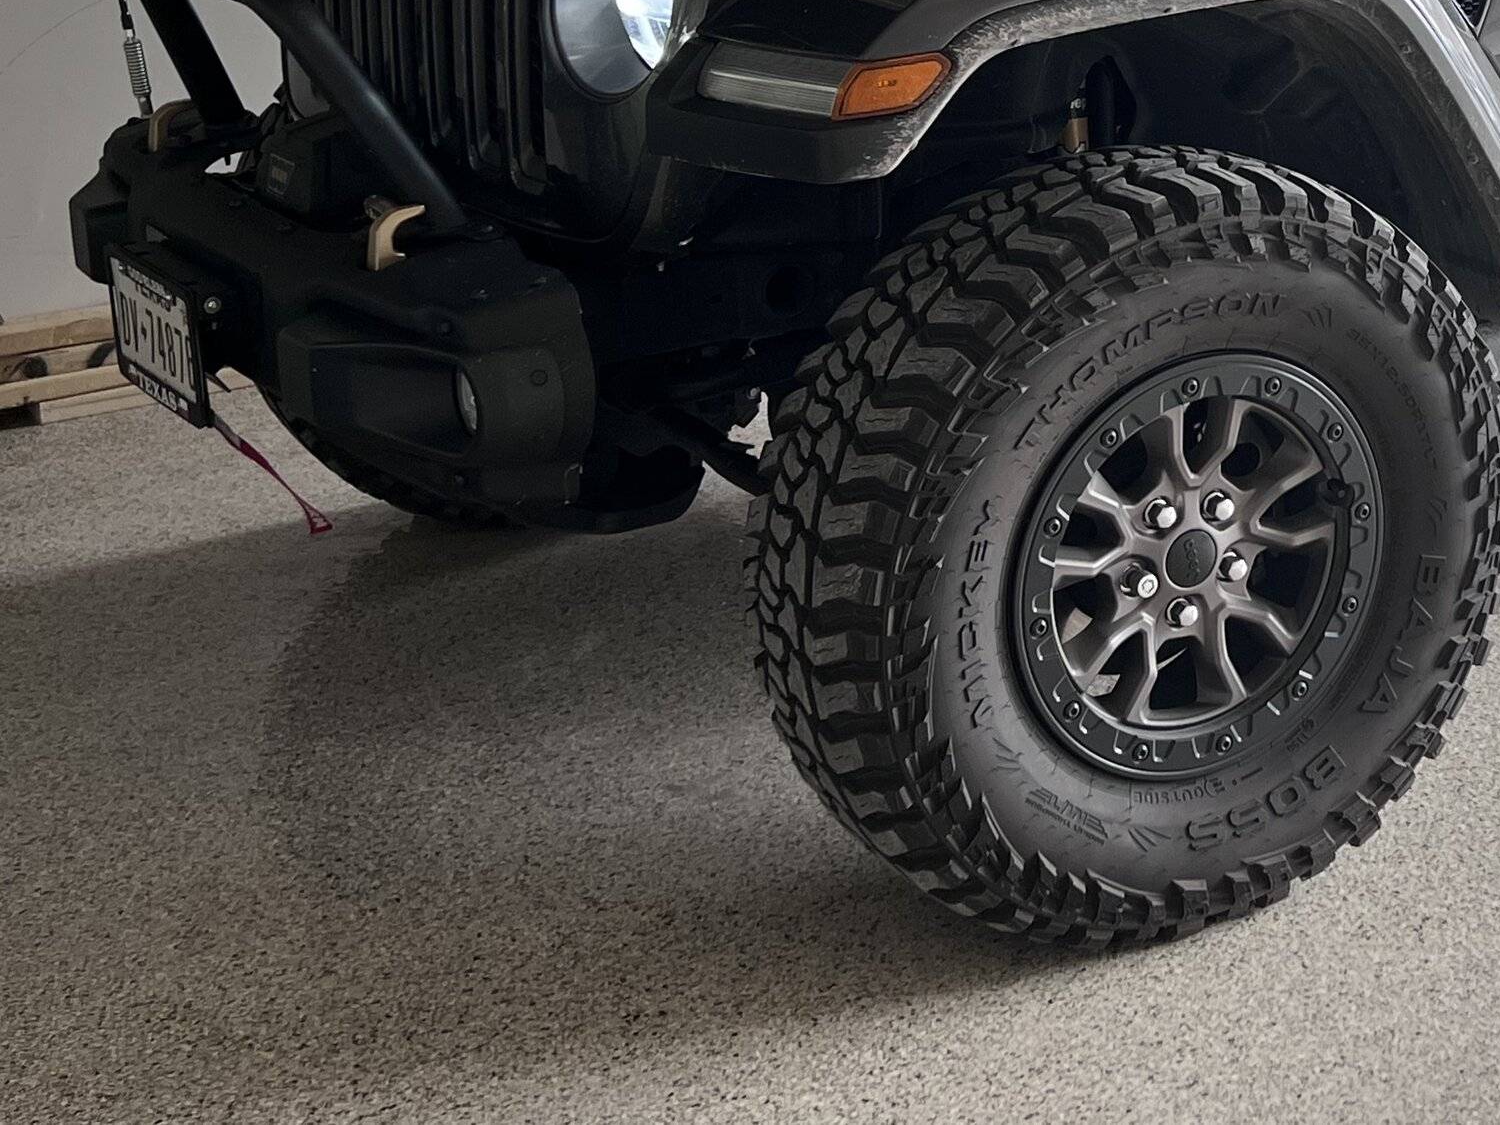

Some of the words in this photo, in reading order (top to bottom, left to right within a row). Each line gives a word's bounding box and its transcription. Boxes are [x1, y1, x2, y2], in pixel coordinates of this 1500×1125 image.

[1012, 291, 1286, 451] THOMPSON
[1358, 554, 1447, 714] BAJA
[1185, 743, 1348, 851] BOSS
